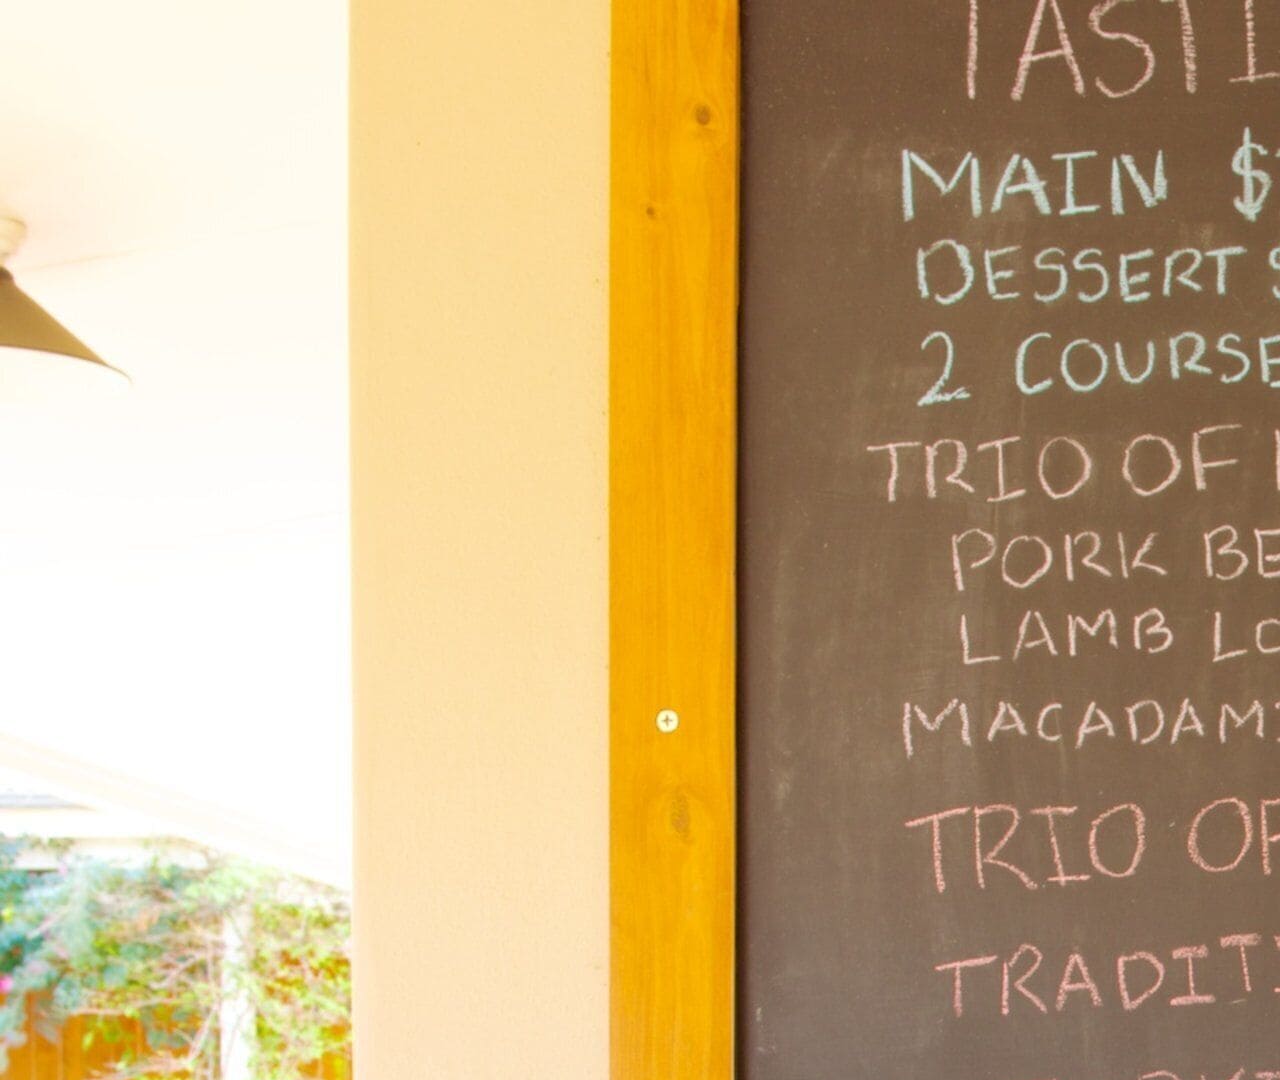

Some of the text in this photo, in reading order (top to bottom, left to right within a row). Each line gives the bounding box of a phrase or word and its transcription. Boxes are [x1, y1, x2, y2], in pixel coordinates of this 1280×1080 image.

[901, 149, 1167, 221] MAIN
[917, 239, 1247, 304] DESSERT
[917, 331, 970, 406] 2
[866, 436, 1093, 502] TRIO
[1122, 424, 1241, 496] OF
[952, 528, 1167, 591] PORK
[960, 608, 1173, 664] LAMB
[905, 803, 1146, 893] TRIO
